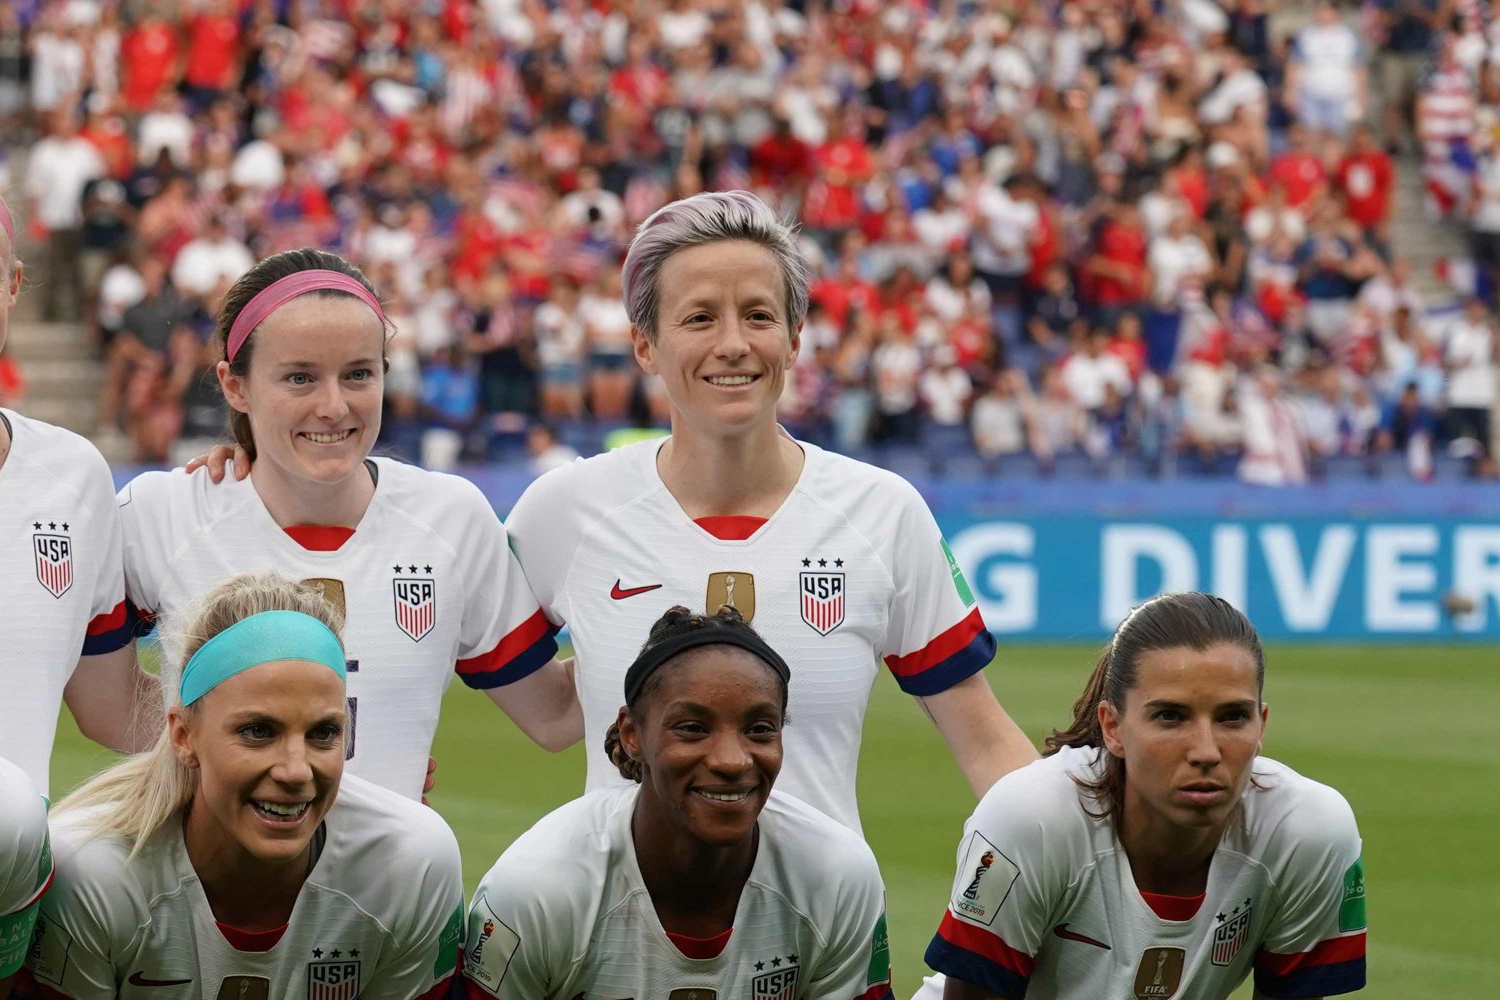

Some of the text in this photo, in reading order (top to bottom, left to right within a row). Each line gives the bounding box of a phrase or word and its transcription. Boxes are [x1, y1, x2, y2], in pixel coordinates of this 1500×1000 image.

[37, 539, 69, 562] USA
[397, 583, 432, 606] USA
[804, 576, 841, 600] USA
[969, 905, 986, 917] 2019
[1217, 912, 1249, 941] USA
[313, 964, 356, 985] USA
[476, 969, 492, 982] 2019
[757, 970, 796, 995] USA
[1144, 985, 1166, 994] FIFA
